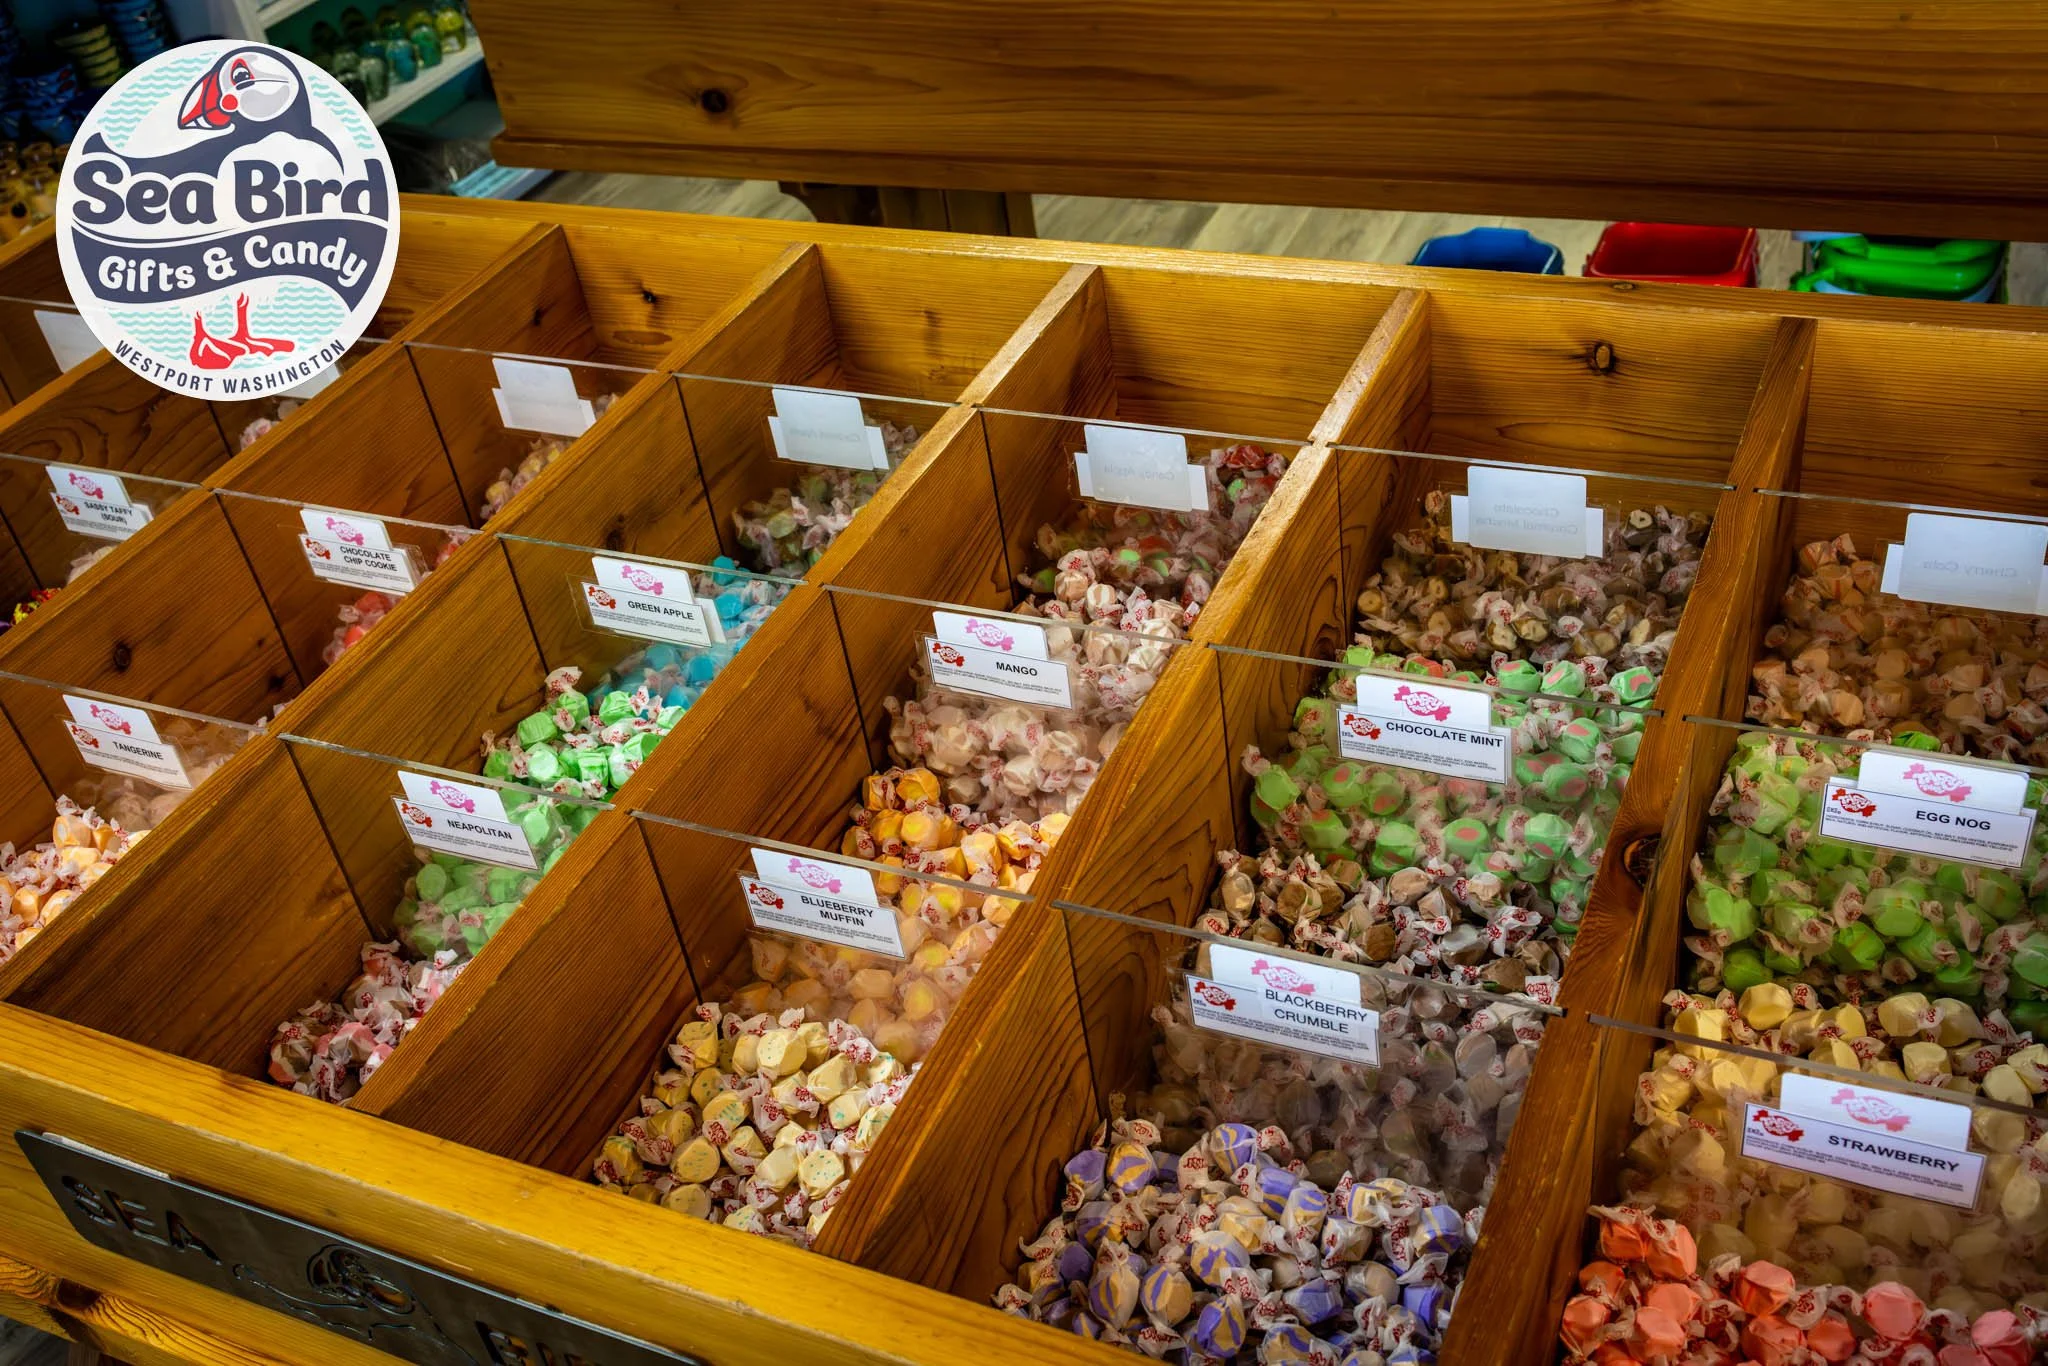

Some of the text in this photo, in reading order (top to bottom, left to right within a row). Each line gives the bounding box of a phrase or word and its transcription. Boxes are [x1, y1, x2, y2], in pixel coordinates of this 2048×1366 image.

[340, 545, 392, 561] CHOCOLATE
[344, 555, 398, 571] CHIP COOKIE
[628, 600, 695, 620] GREEN APPLE
[995, 661, 1038, 677] MANGO
[1386, 721, 1503, 748] CHOCOLATE MINT
[112, 741, 164, 760] TANGERINE
[447, 819, 513, 840] NEAPOLITAN
[1916, 810, 1991, 831] EGG NOG
[800, 895, 874, 918] BLUEBERRY
[820, 910, 865, 927] MUFFIN
[1265, 989, 1368, 1022] BLACKBERRY
[1274, 1008, 1349, 1034] CRUMBLE
[1828, 1134, 1960, 1173] STRAWBERRY
[62, 1175, 222, 1266] SEA
